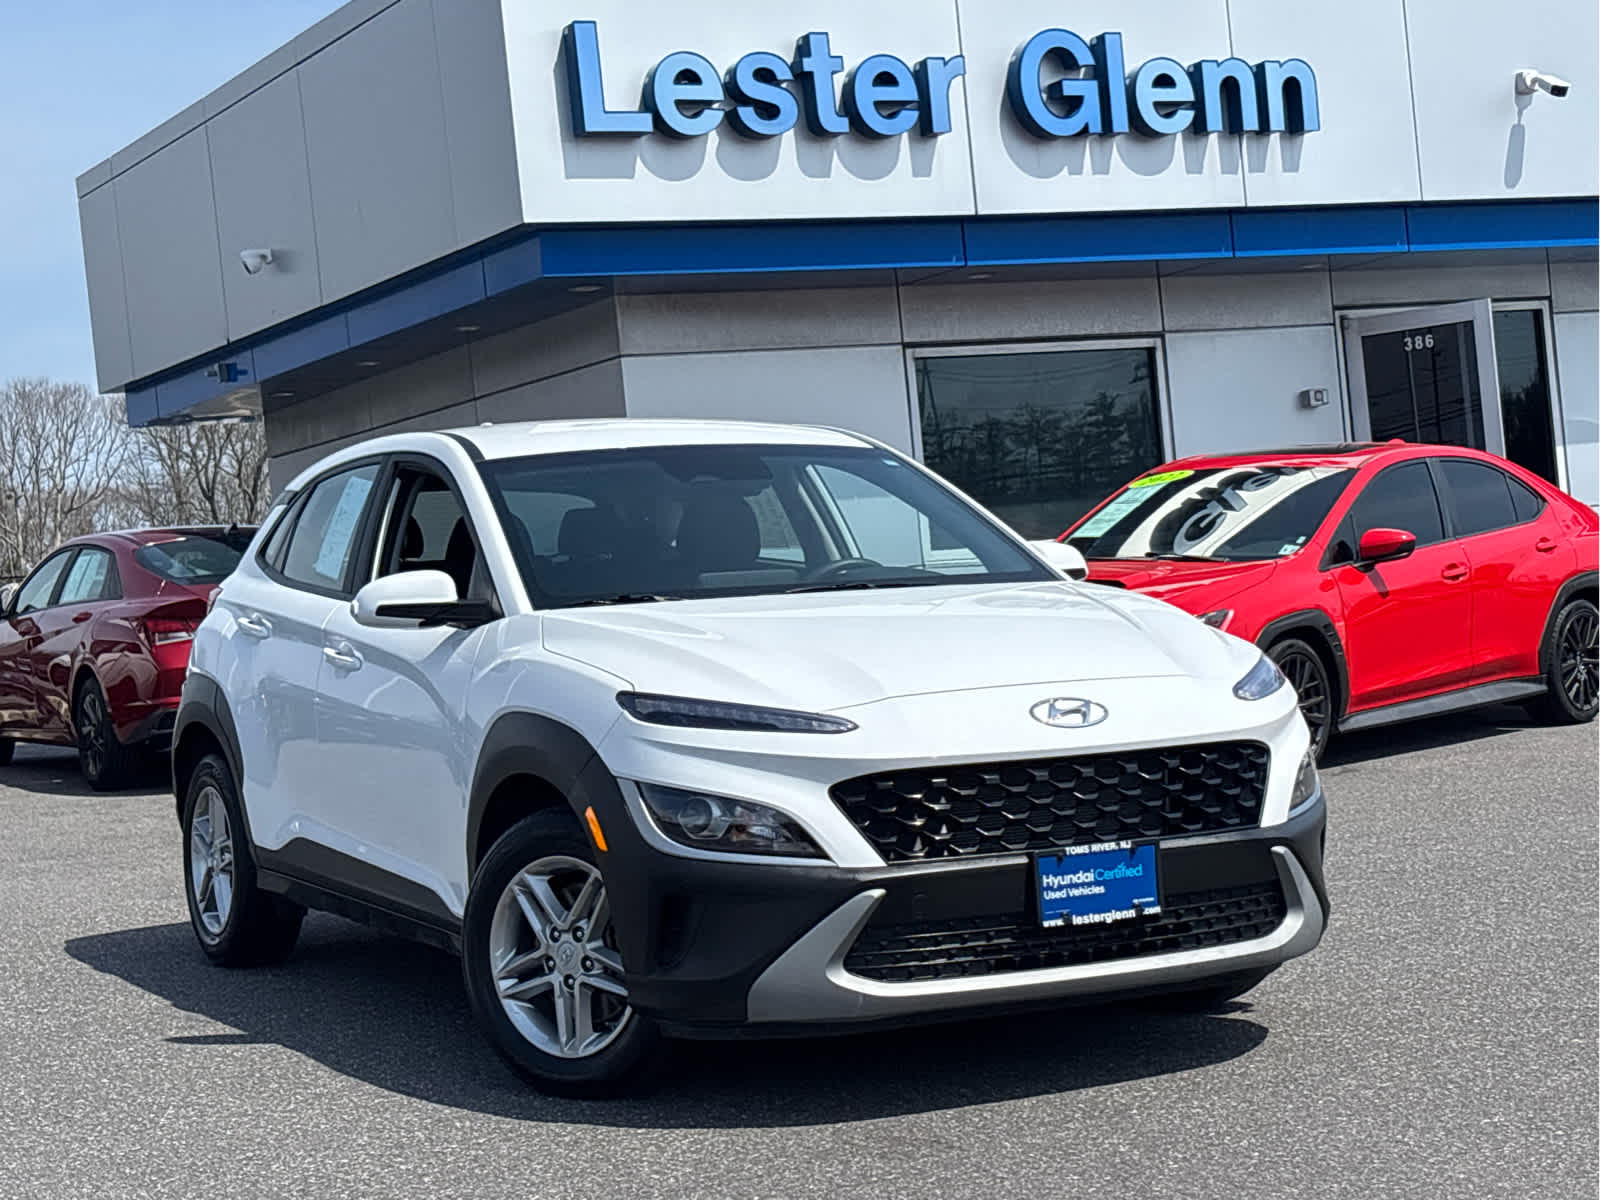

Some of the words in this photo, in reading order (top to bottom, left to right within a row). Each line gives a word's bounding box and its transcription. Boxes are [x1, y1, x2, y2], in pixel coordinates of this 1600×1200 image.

[564, 21, 966, 138] Lester
[1007, 28, 1320, 137] Glenn
[1403, 334, 1434, 351] 386
[1065, 845, 1089, 855] TOMS
[1091, 842, 1119, 852] RIVER,
[1119, 840, 1132, 848] NJ
[1043, 888, 1067, 900] Used
[1067, 885, 1105, 897] Vehicles
[1072, 909, 1136, 926] lesterglenn
